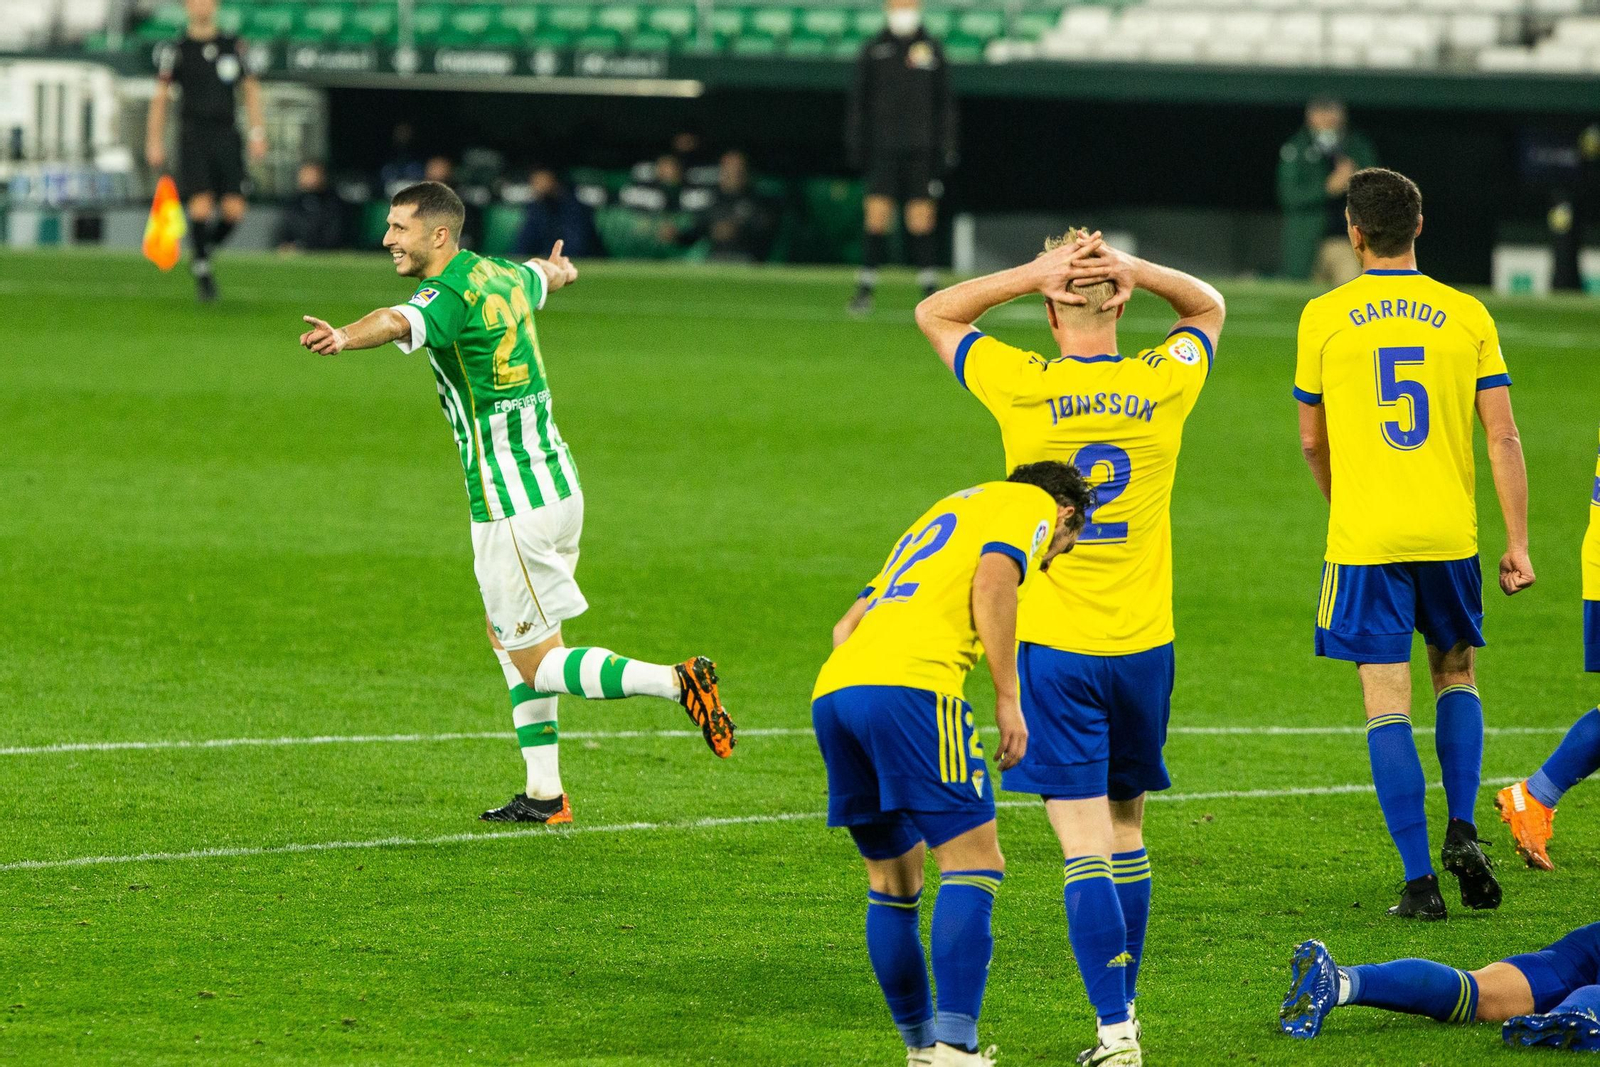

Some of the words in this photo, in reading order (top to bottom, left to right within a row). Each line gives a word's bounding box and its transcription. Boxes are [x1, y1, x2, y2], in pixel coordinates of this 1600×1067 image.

[482, 285, 547, 390] 21
[1349, 299, 1447, 329] GARRIDO
[1046, 392, 1157, 426] JØNSSON
[1373, 346, 1430, 451] 5
[1067, 443, 1131, 545] 2
